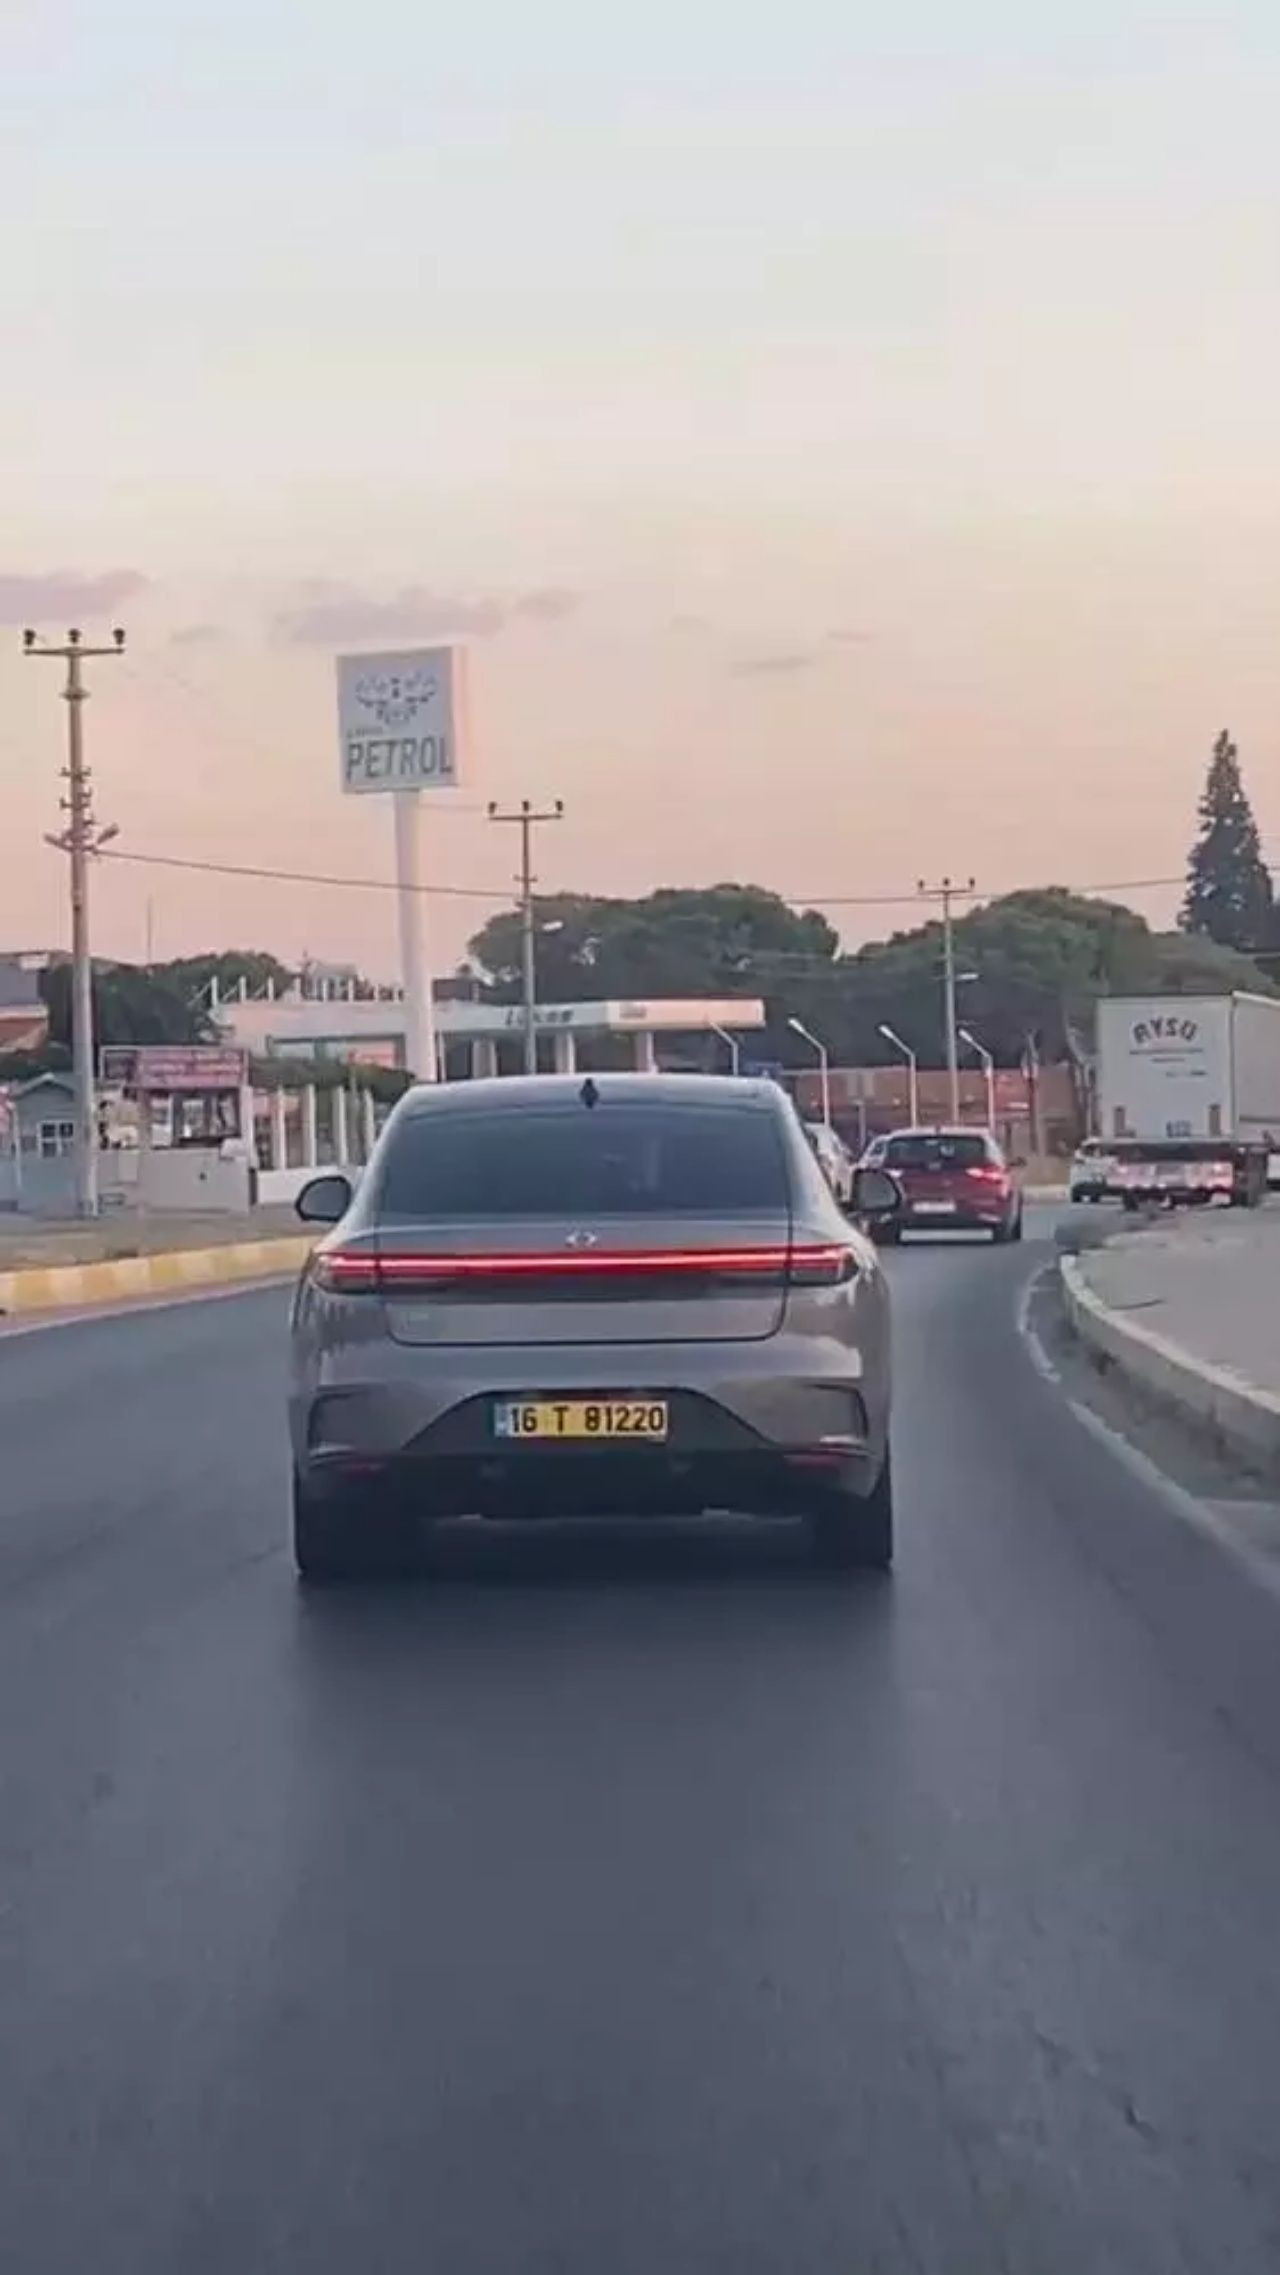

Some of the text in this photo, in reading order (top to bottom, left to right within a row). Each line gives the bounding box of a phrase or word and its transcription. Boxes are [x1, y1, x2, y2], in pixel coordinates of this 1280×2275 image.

[346, 736, 453, 783] PETROL
[511, 1406, 664, 1433] 16 T 81220
